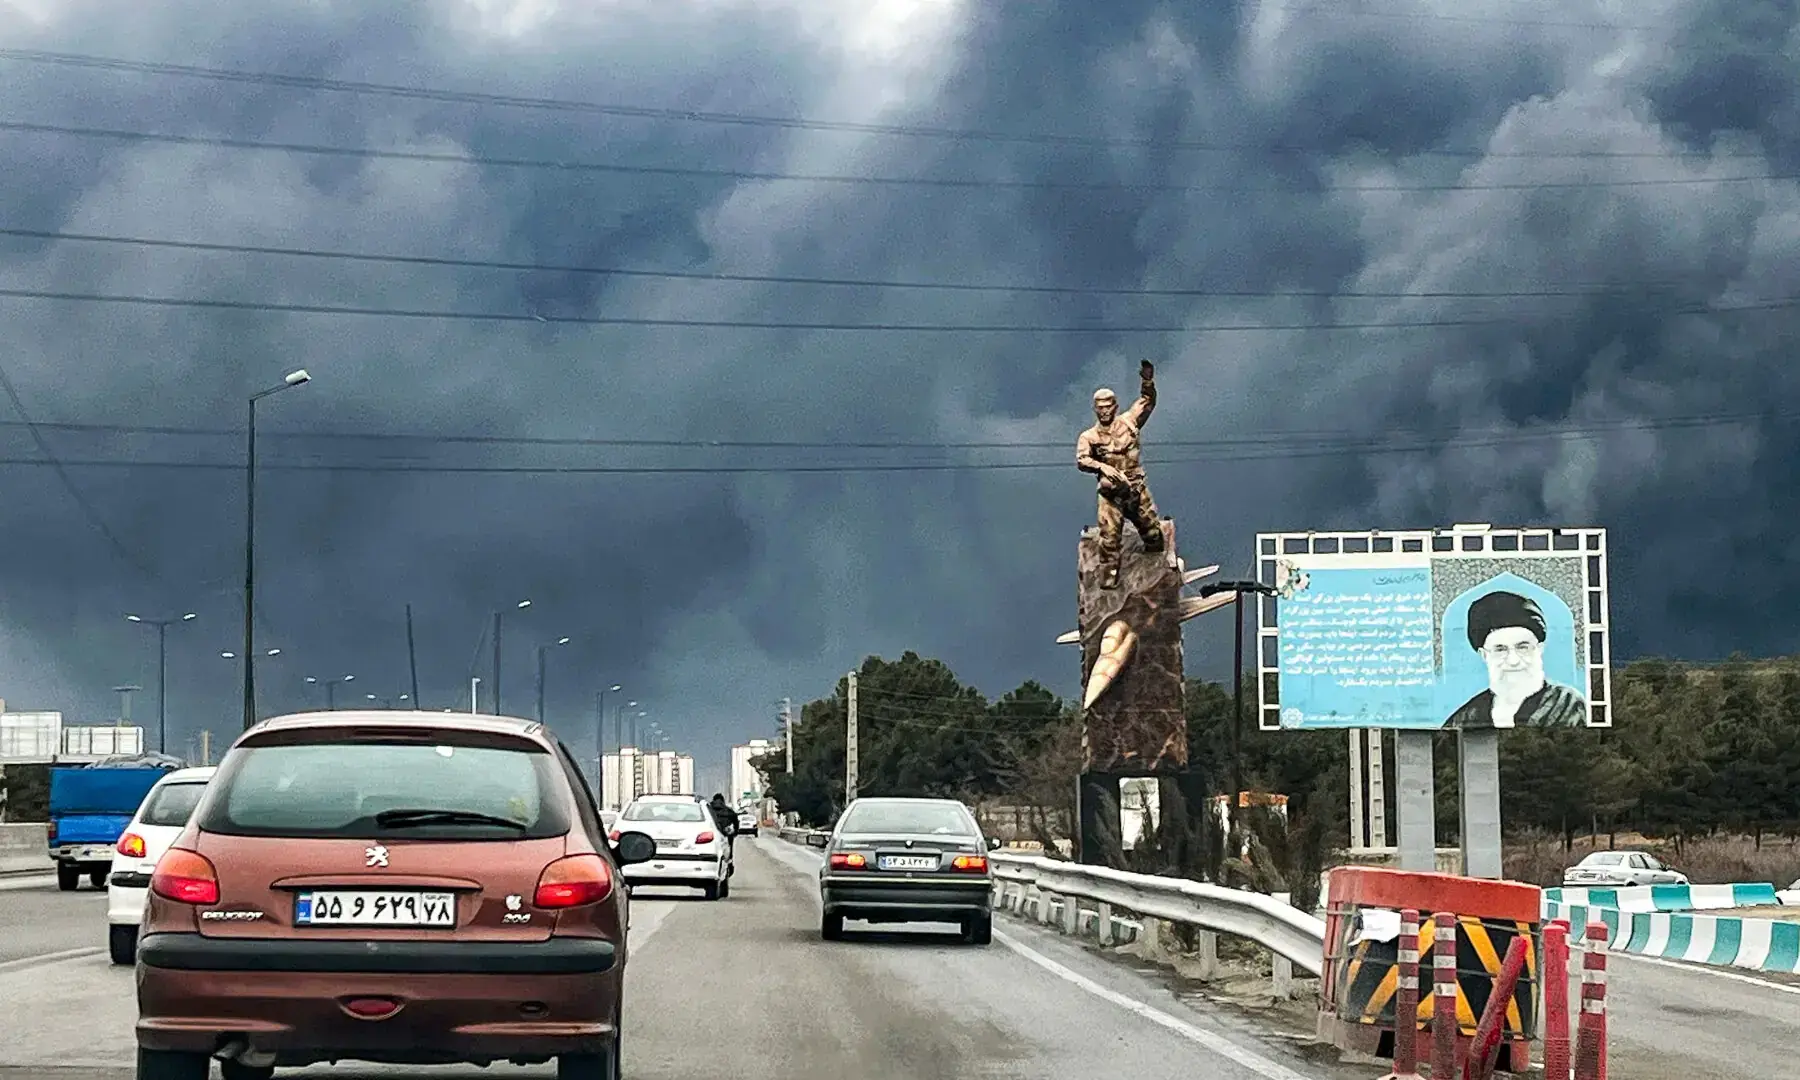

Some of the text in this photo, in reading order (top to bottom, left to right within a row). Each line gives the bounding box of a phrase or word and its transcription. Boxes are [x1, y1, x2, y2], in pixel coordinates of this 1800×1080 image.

[315, 896, 450, 922] ۵۵ و ۶۲۹ ۷۸
